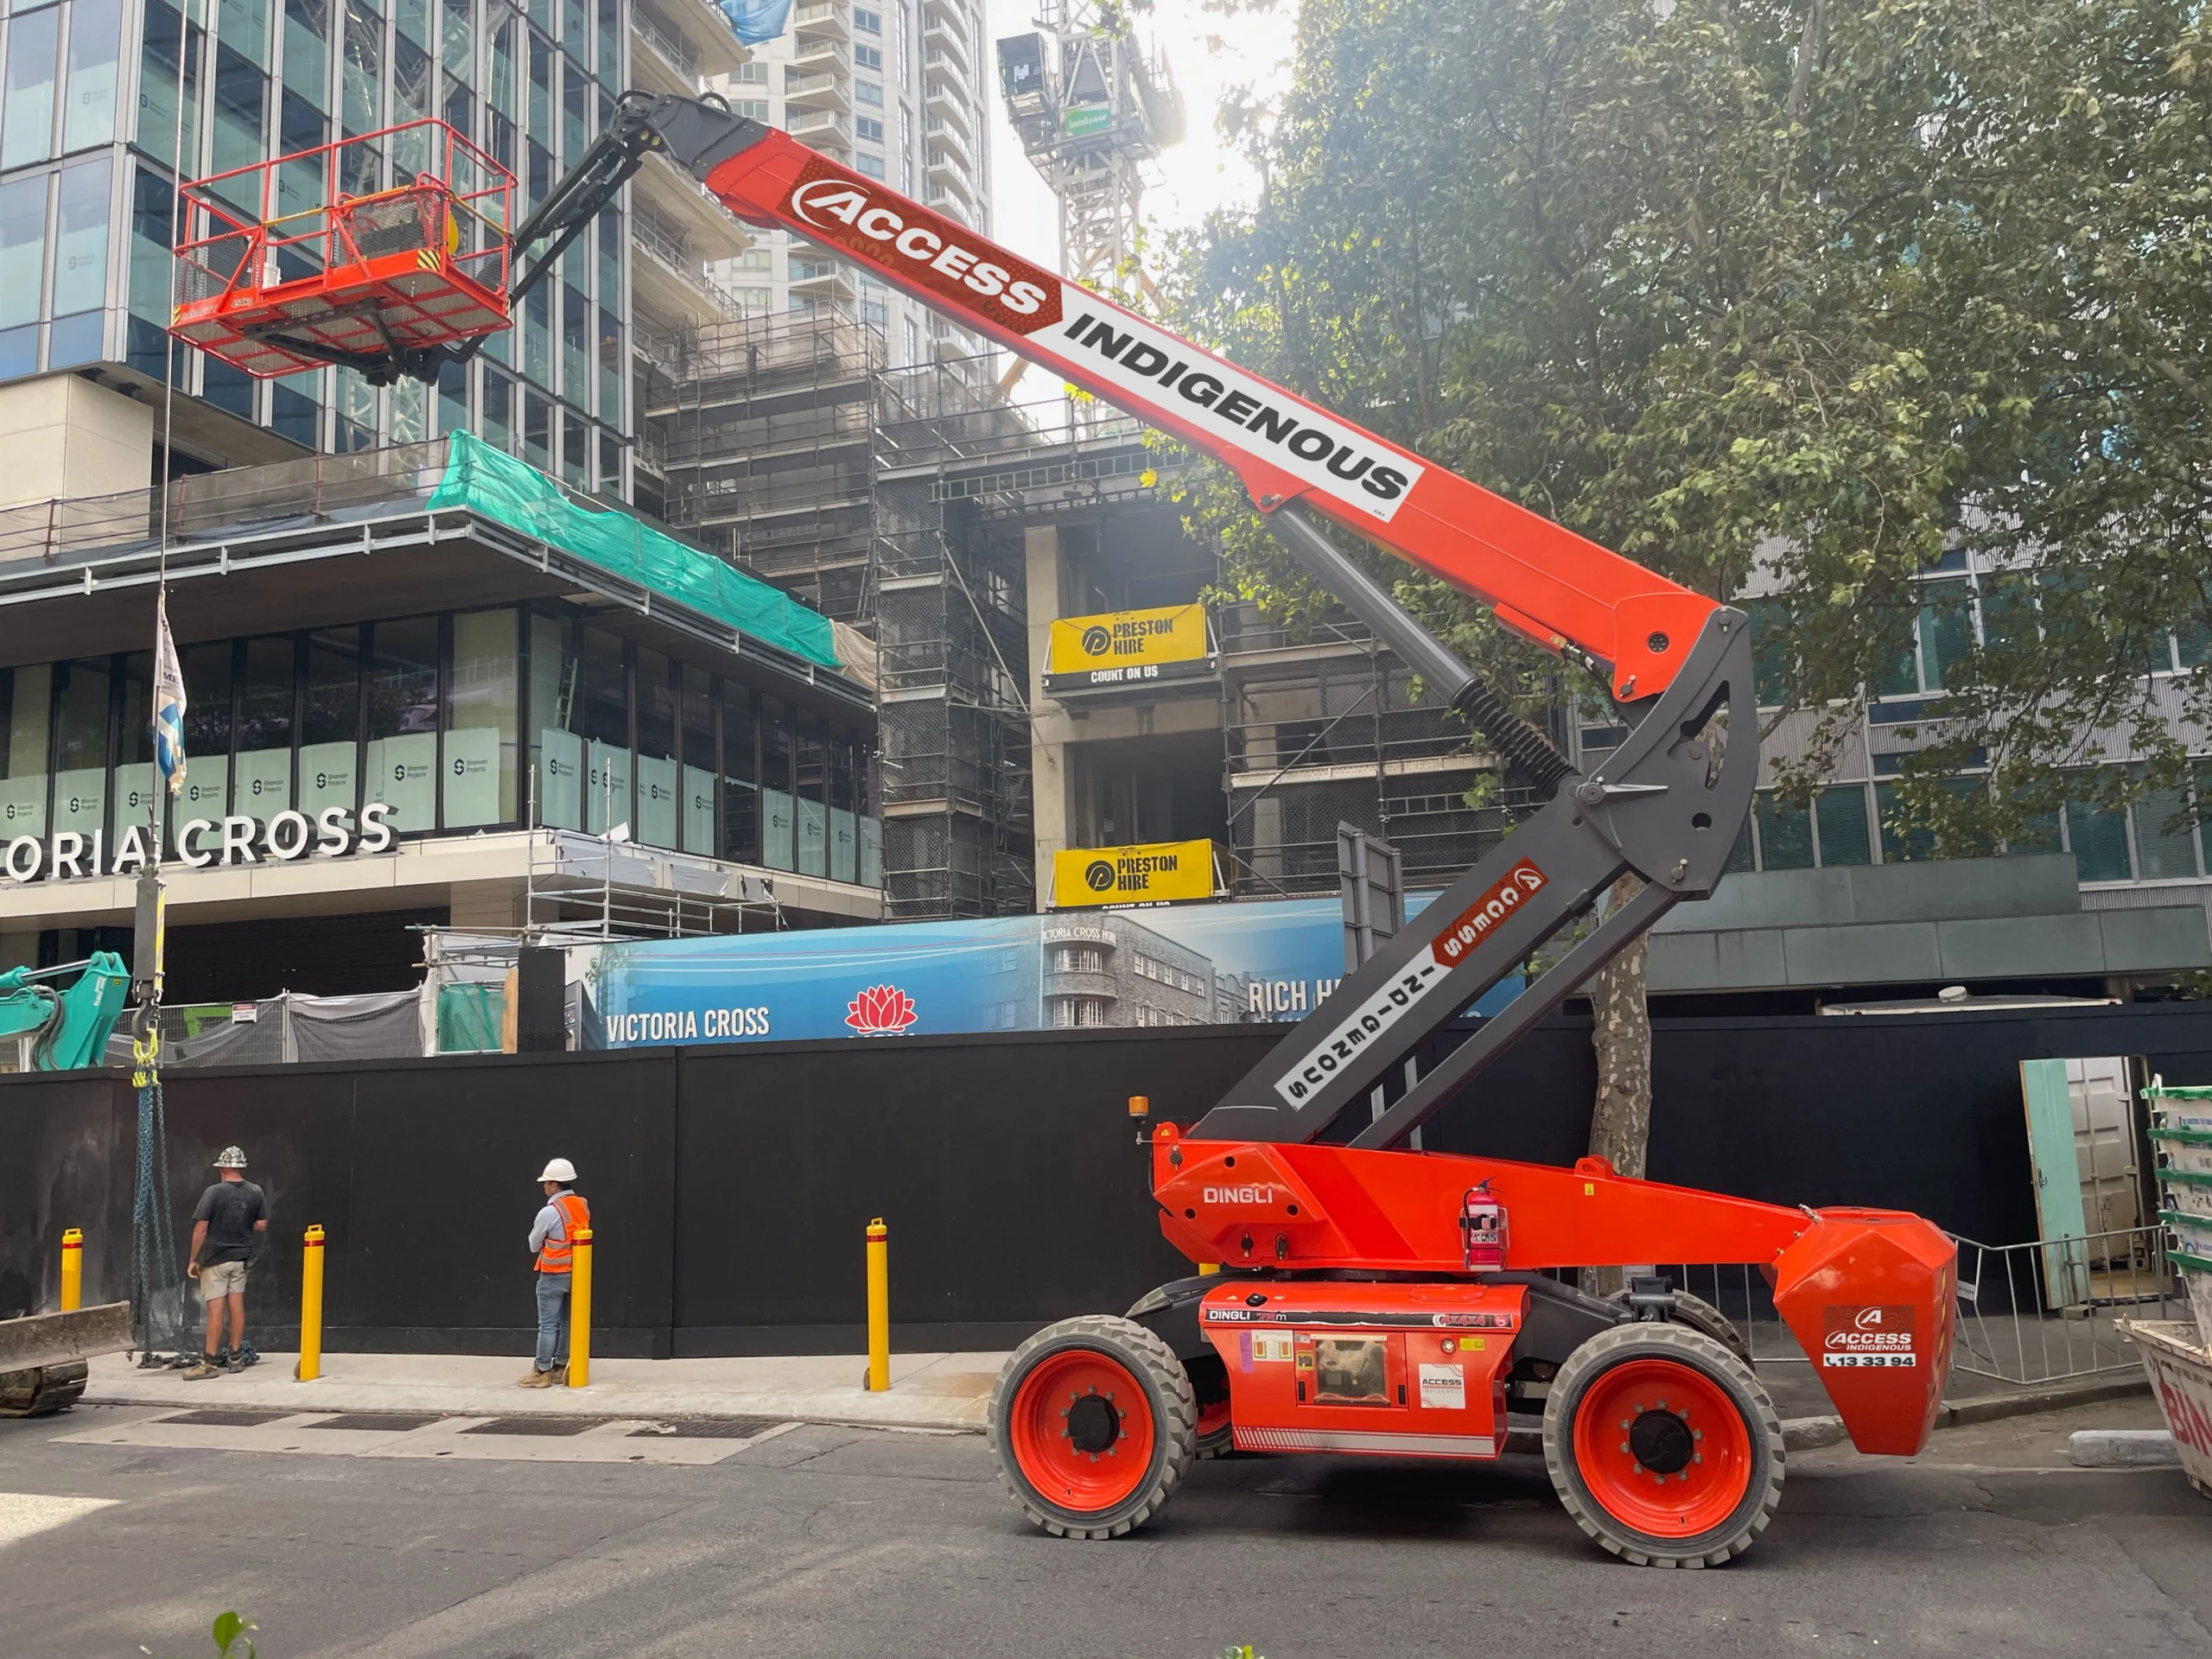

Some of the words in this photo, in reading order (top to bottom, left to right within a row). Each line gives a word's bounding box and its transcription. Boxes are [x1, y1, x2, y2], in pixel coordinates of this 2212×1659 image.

[1069, 113, 1107, 129] lendlease
[809, 188, 1046, 316] ACCESS
[1064, 312, 1408, 502] INDIGENOUS
[1113, 618, 1173, 639] PRESTON
[1113, 638, 1144, 655] HIRE
[1090, 668, 1124, 683] COUNT
[1126, 666, 1141, 680] ON
[1144, 664, 1159, 678] US
[178, 802, 392, 868] CROSS
[1117, 855, 1178, 874] PRESTON
[1117, 874, 1149, 891] HIRE
[1444, 872, 1543, 958] ACCESS
[1073, 926, 1101, 938] CROSS
[1249, 980, 1307, 1013] RICH
[1316, 978, 1342, 1007] H
[607, 1010, 698, 1043] VICTORIA
[704, 1007, 770, 1038] CROSS
[1288, 965, 1435, 1098] INDIGENOUS
[1203, 1186, 1273, 1204] DINGLI
[1209, 1310, 1250, 1320] DINGLI
[1826, 1332, 1912, 1346] ACCESS
[1838, 1357, 1858, 1366] 13
[1862, 1357, 1886, 1366] 33
[1891, 1357, 1915, 1366] 94
